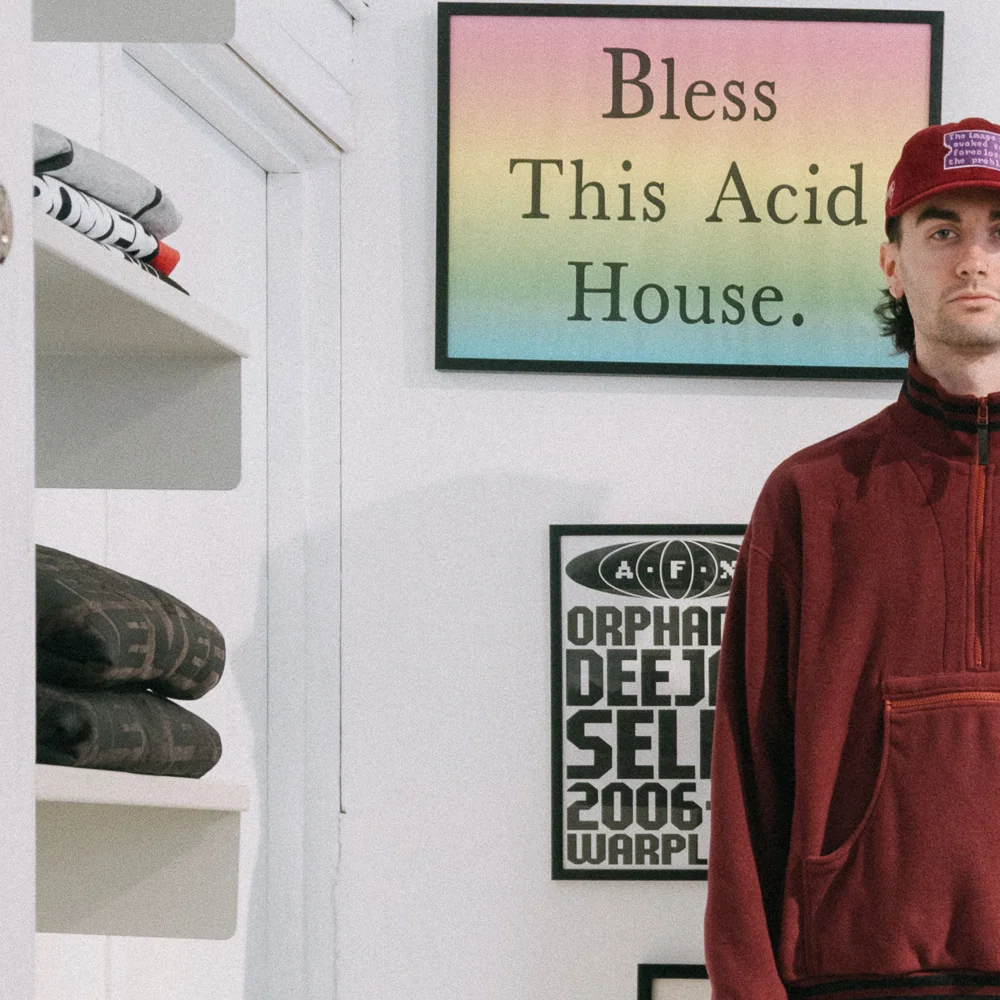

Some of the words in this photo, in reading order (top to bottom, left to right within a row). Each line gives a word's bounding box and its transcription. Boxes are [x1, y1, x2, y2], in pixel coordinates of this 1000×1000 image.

[602, 47, 777, 121] Bless
[948, 158, 965, 166] the
[949, 132, 966, 140] The
[969, 132, 996, 141] image
[509, 158, 667, 222] This
[705, 160, 867, 226] Acid
[567, 261, 804, 328] House.
